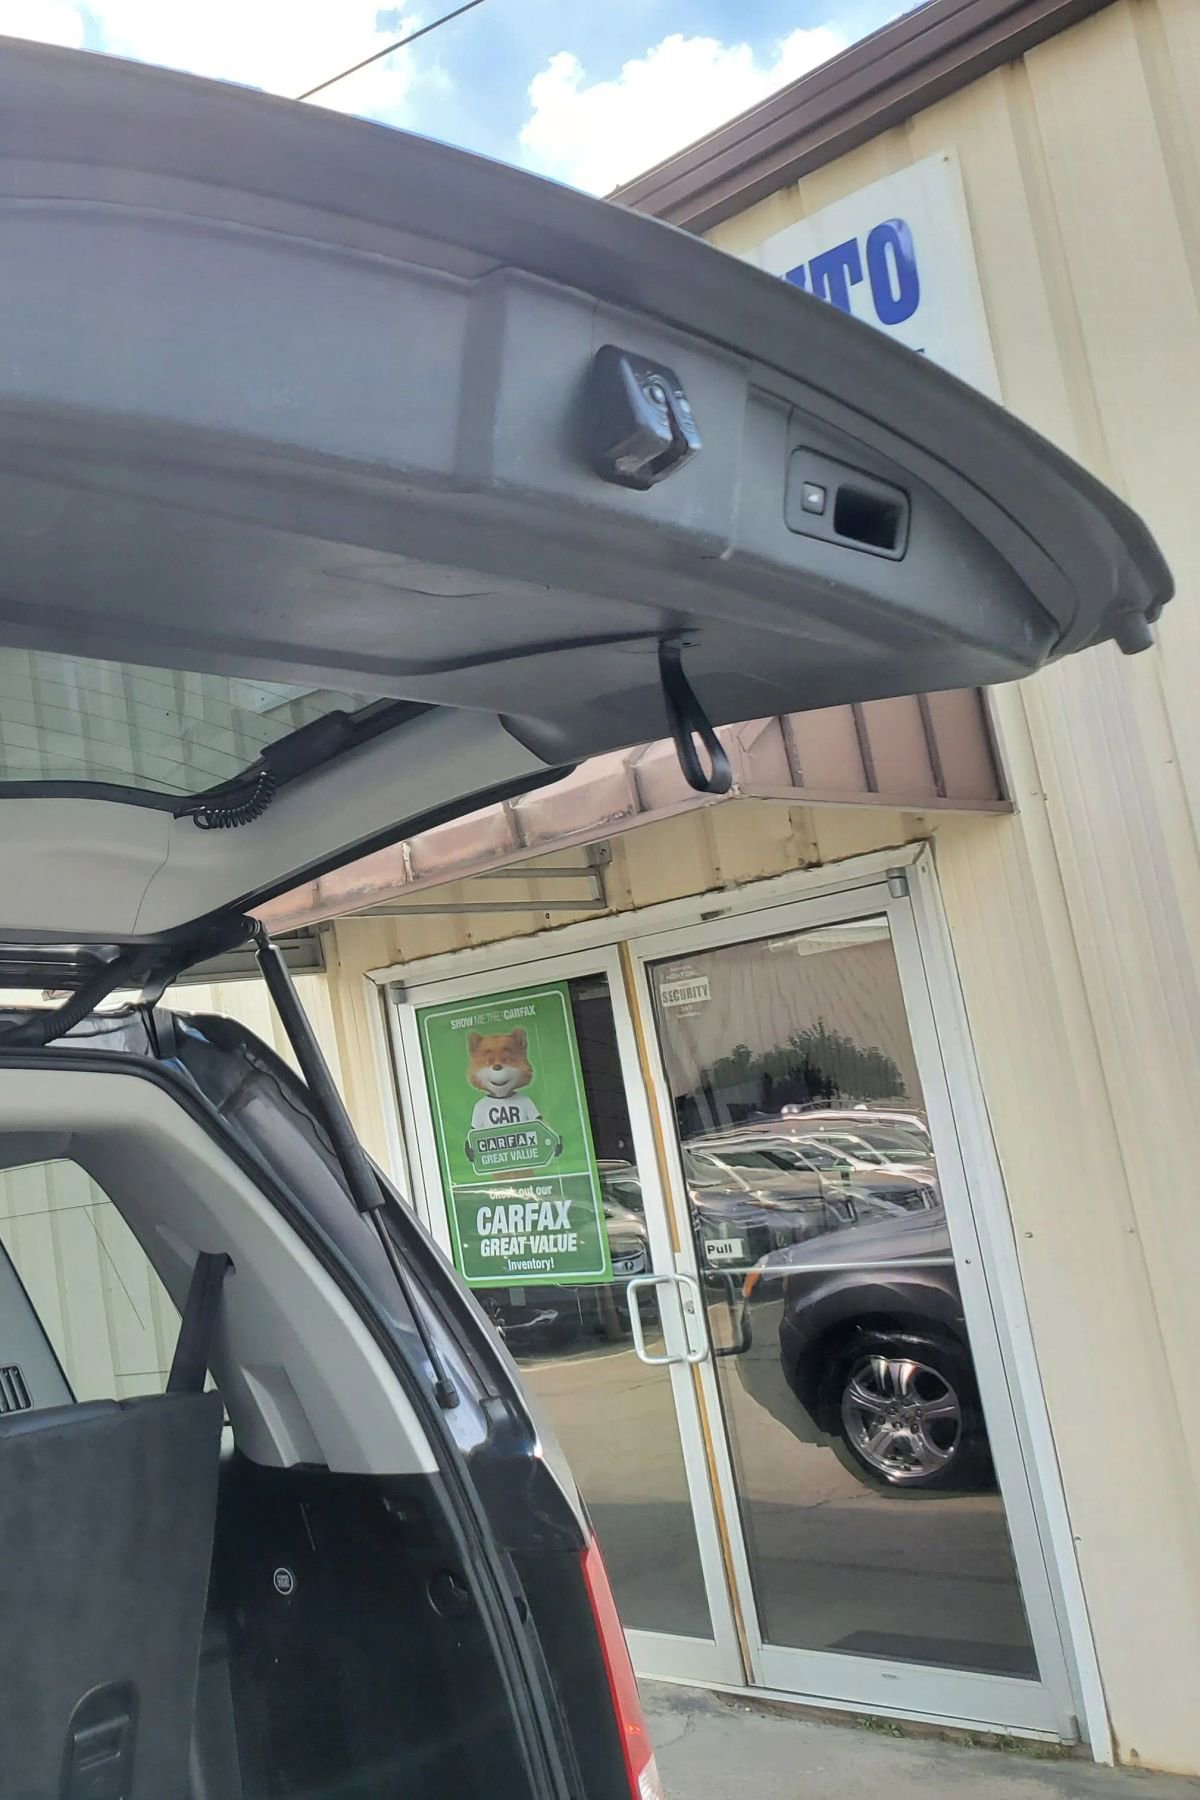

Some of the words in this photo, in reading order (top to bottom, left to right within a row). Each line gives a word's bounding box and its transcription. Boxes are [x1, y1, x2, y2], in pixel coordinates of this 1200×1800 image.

[786, 217, 920, 326] TO
[662, 983, 708, 1004] SECURITY
[450, 1015, 473, 1030] SHOW
[503, 1004, 536, 1020] CARFAX
[488, 1105, 520, 1125] CAR
[478, 1132, 537, 1151] CARFAX
[481, 1152, 510, 1165] GREAT
[510, 1148, 539, 1161] VALUE
[518, 1185, 533, 1199] out
[536, 1185, 552, 1196] our
[476, 1200, 572, 1236] CARFAX
[481, 1236, 527, 1257] GREAT
[530, 1233, 577, 1254] VALUE
[707, 1244, 733, 1255] Pull
[508, 1257, 554, 1271] Inventory!
